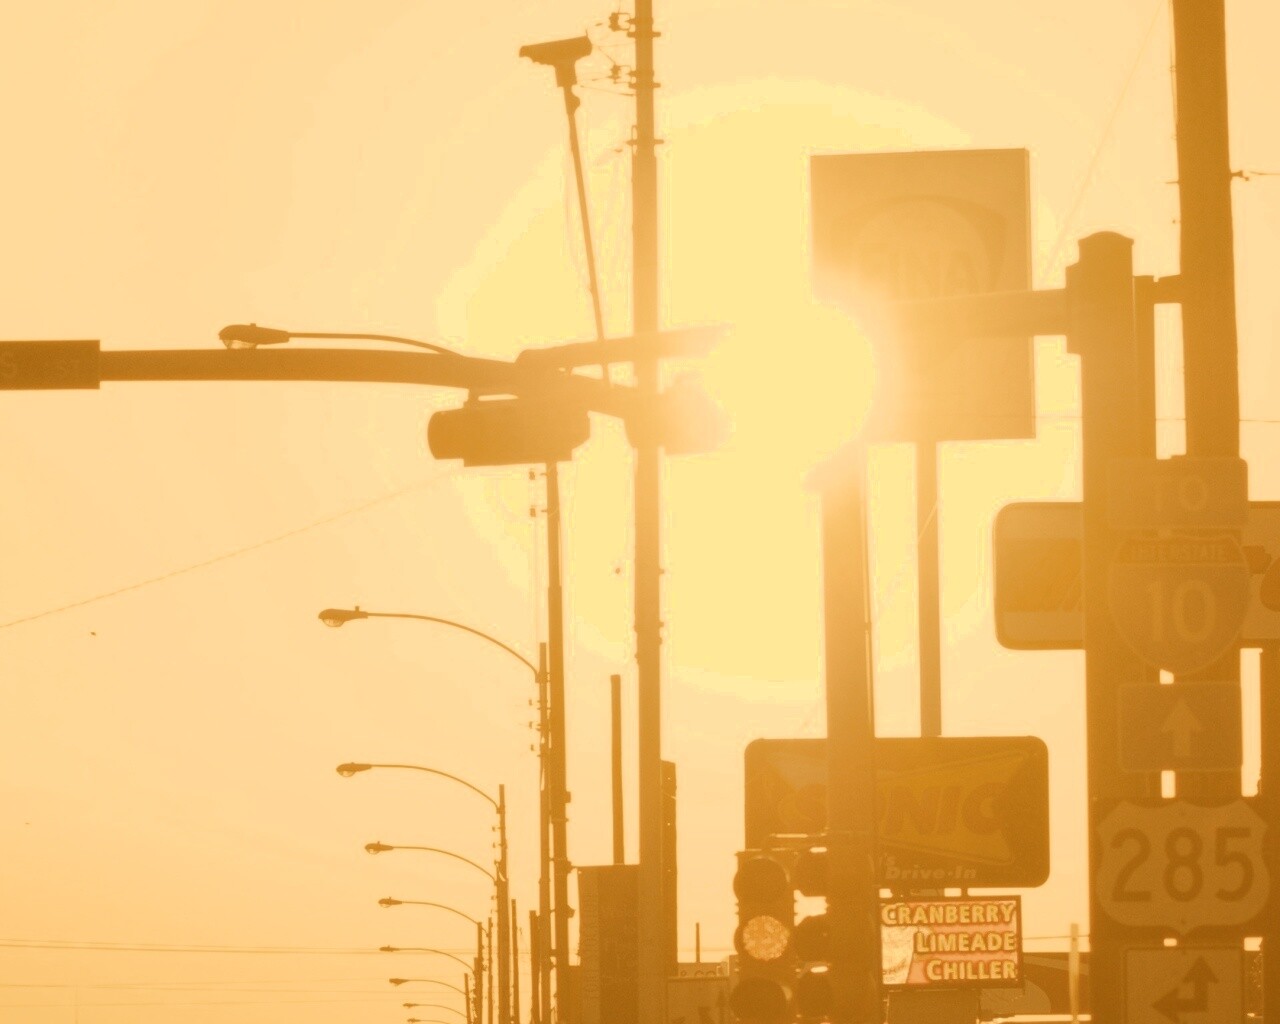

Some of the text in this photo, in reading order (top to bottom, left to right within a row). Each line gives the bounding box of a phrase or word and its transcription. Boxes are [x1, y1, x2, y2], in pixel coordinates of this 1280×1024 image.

[1146, 475, 1208, 511] TO
[1146, 579, 1217, 641] 10
[782, 783, 1007, 834] SNIC
[1111, 827, 1254, 901] 285
[881, 904, 1015, 926] CRANBERRY
[916, 930, 1017, 953] LIMEADE
[926, 959, 1017, 982] CHILLER
